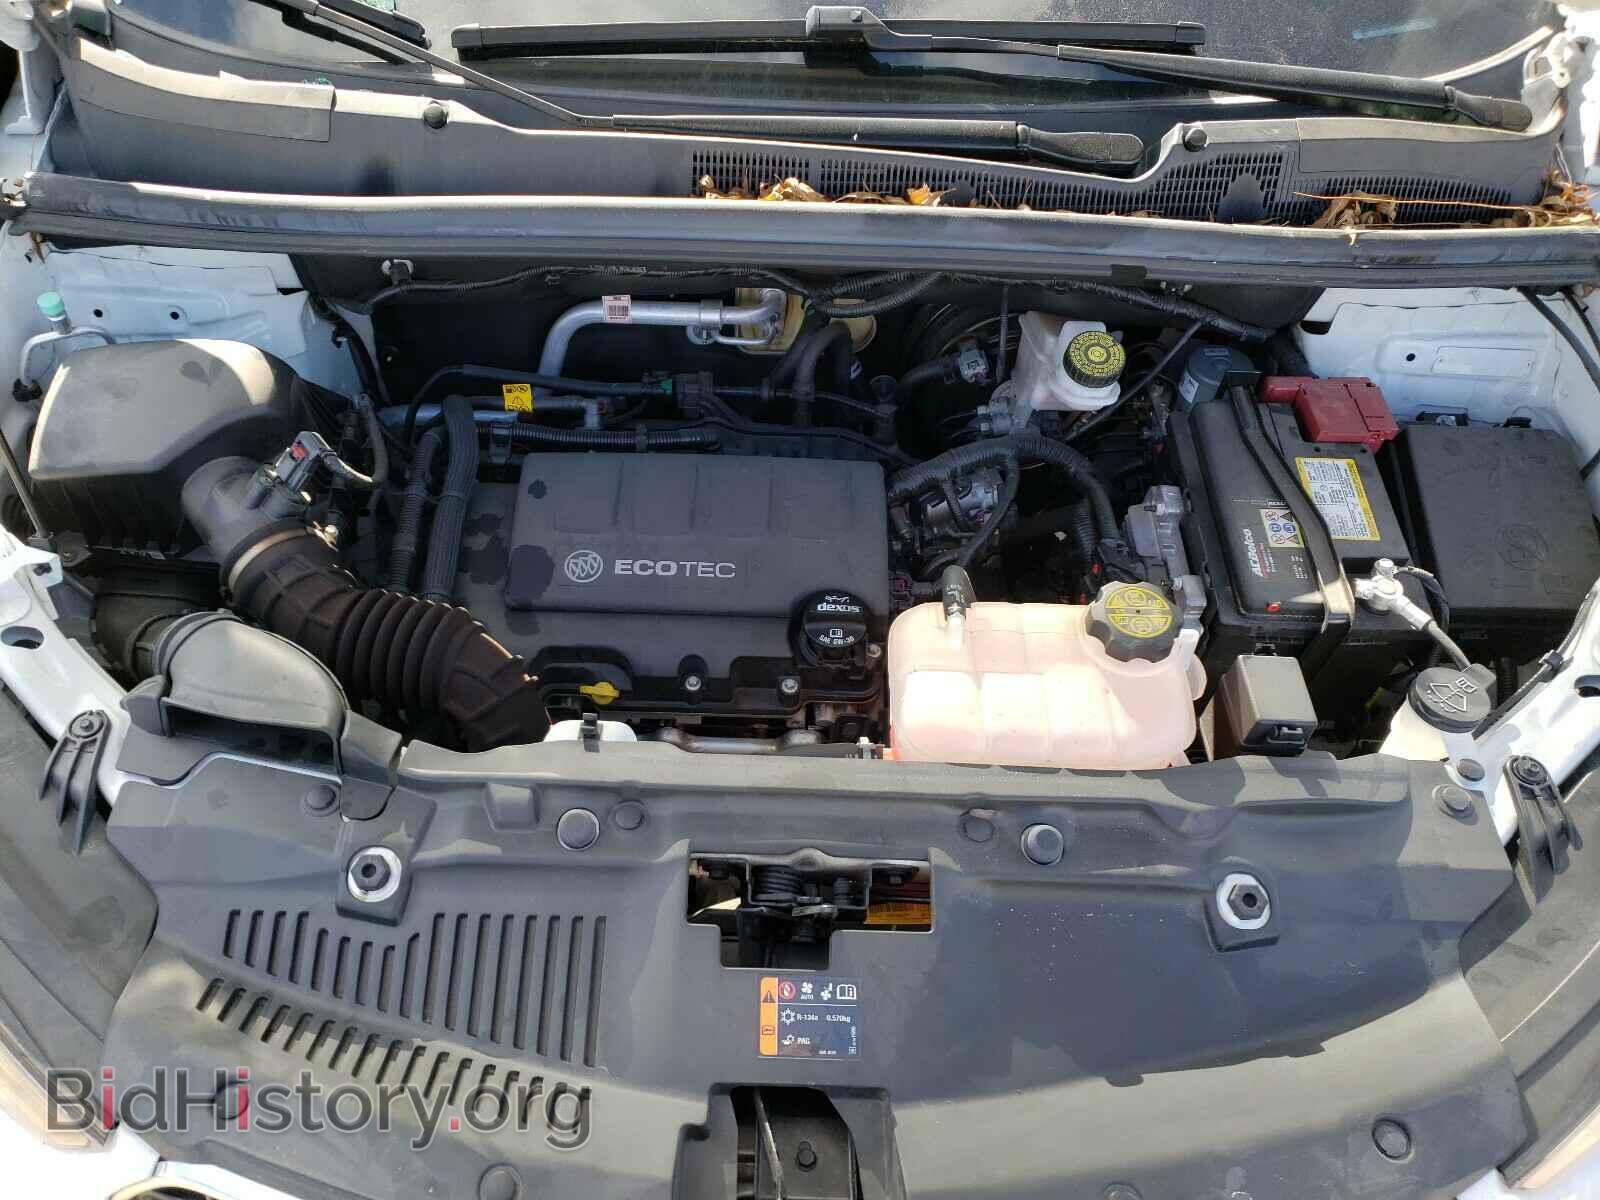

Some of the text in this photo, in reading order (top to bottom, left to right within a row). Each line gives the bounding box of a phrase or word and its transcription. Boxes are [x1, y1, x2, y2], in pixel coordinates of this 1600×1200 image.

[614, 559, 736, 578] ECOTEC
[817, 602, 861, 613] dexos
[818, 634, 831, 644] SAE
[796, 1013, 851, 1023] R-134a 0.570kg
[797, 1037, 810, 1045] PAG
